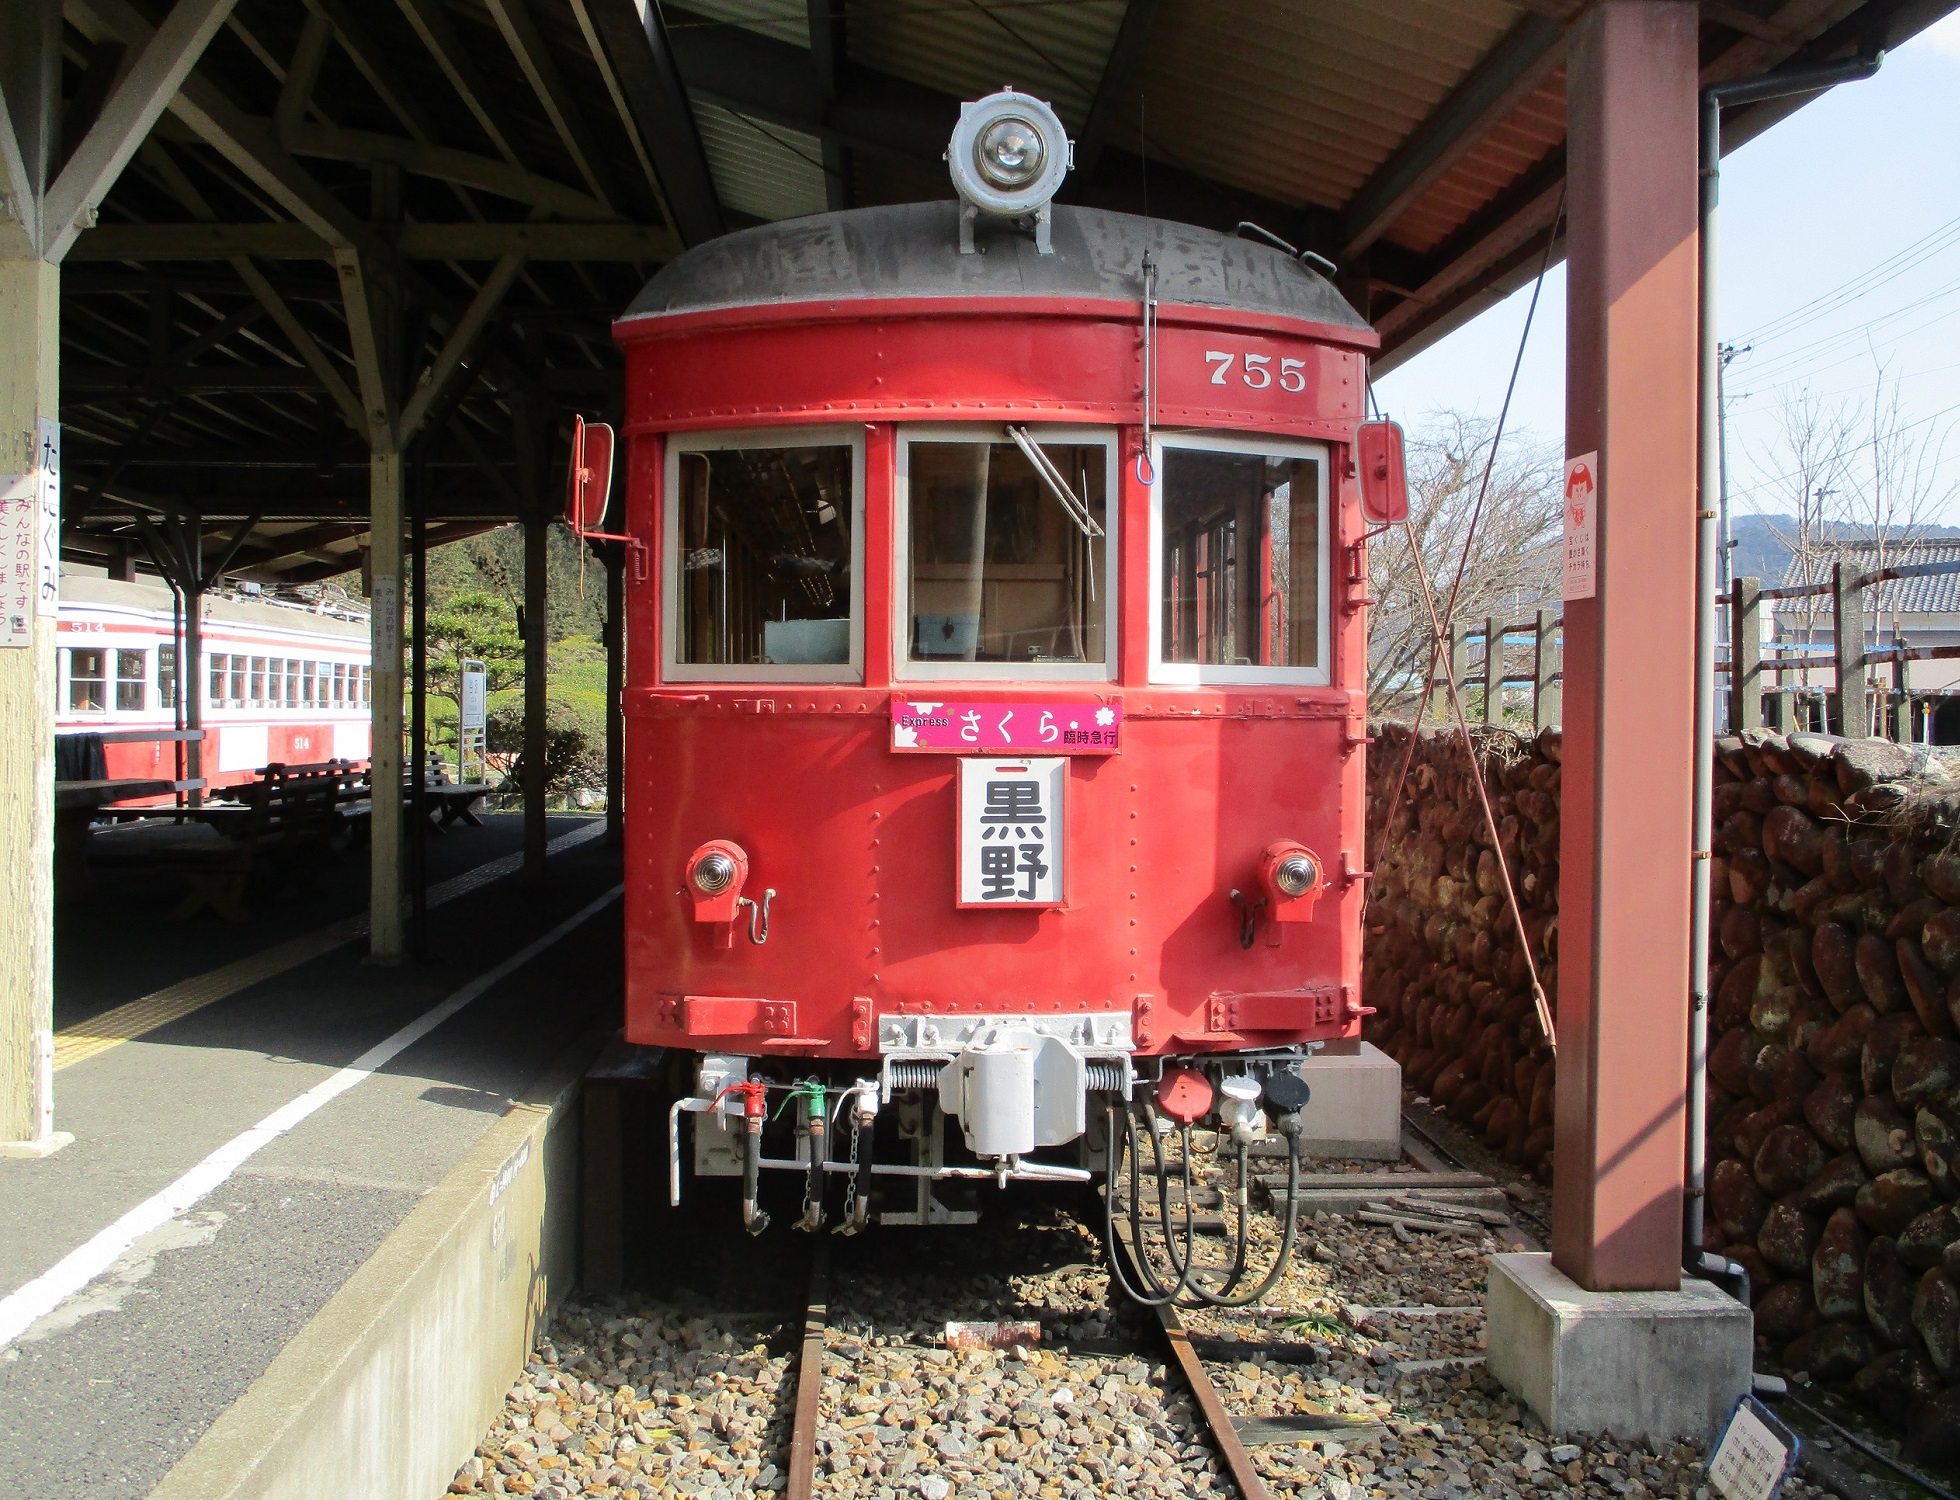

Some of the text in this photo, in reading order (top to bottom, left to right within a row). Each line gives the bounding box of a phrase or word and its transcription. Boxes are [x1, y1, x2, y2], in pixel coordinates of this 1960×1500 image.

[1204, 350, 1307, 393] 755
[43, 434, 58, 602] たにぐみ
[15, 499, 31, 610] みんなの駅です
[70, 622, 106, 633] 514
[901, 714, 950, 728] Express
[959, 709, 1060, 744] さくら
[1063, 730, 1117, 745] 臨時急行
[294, 737, 311, 750] 514
[980, 780, 1049, 901] 黒野
